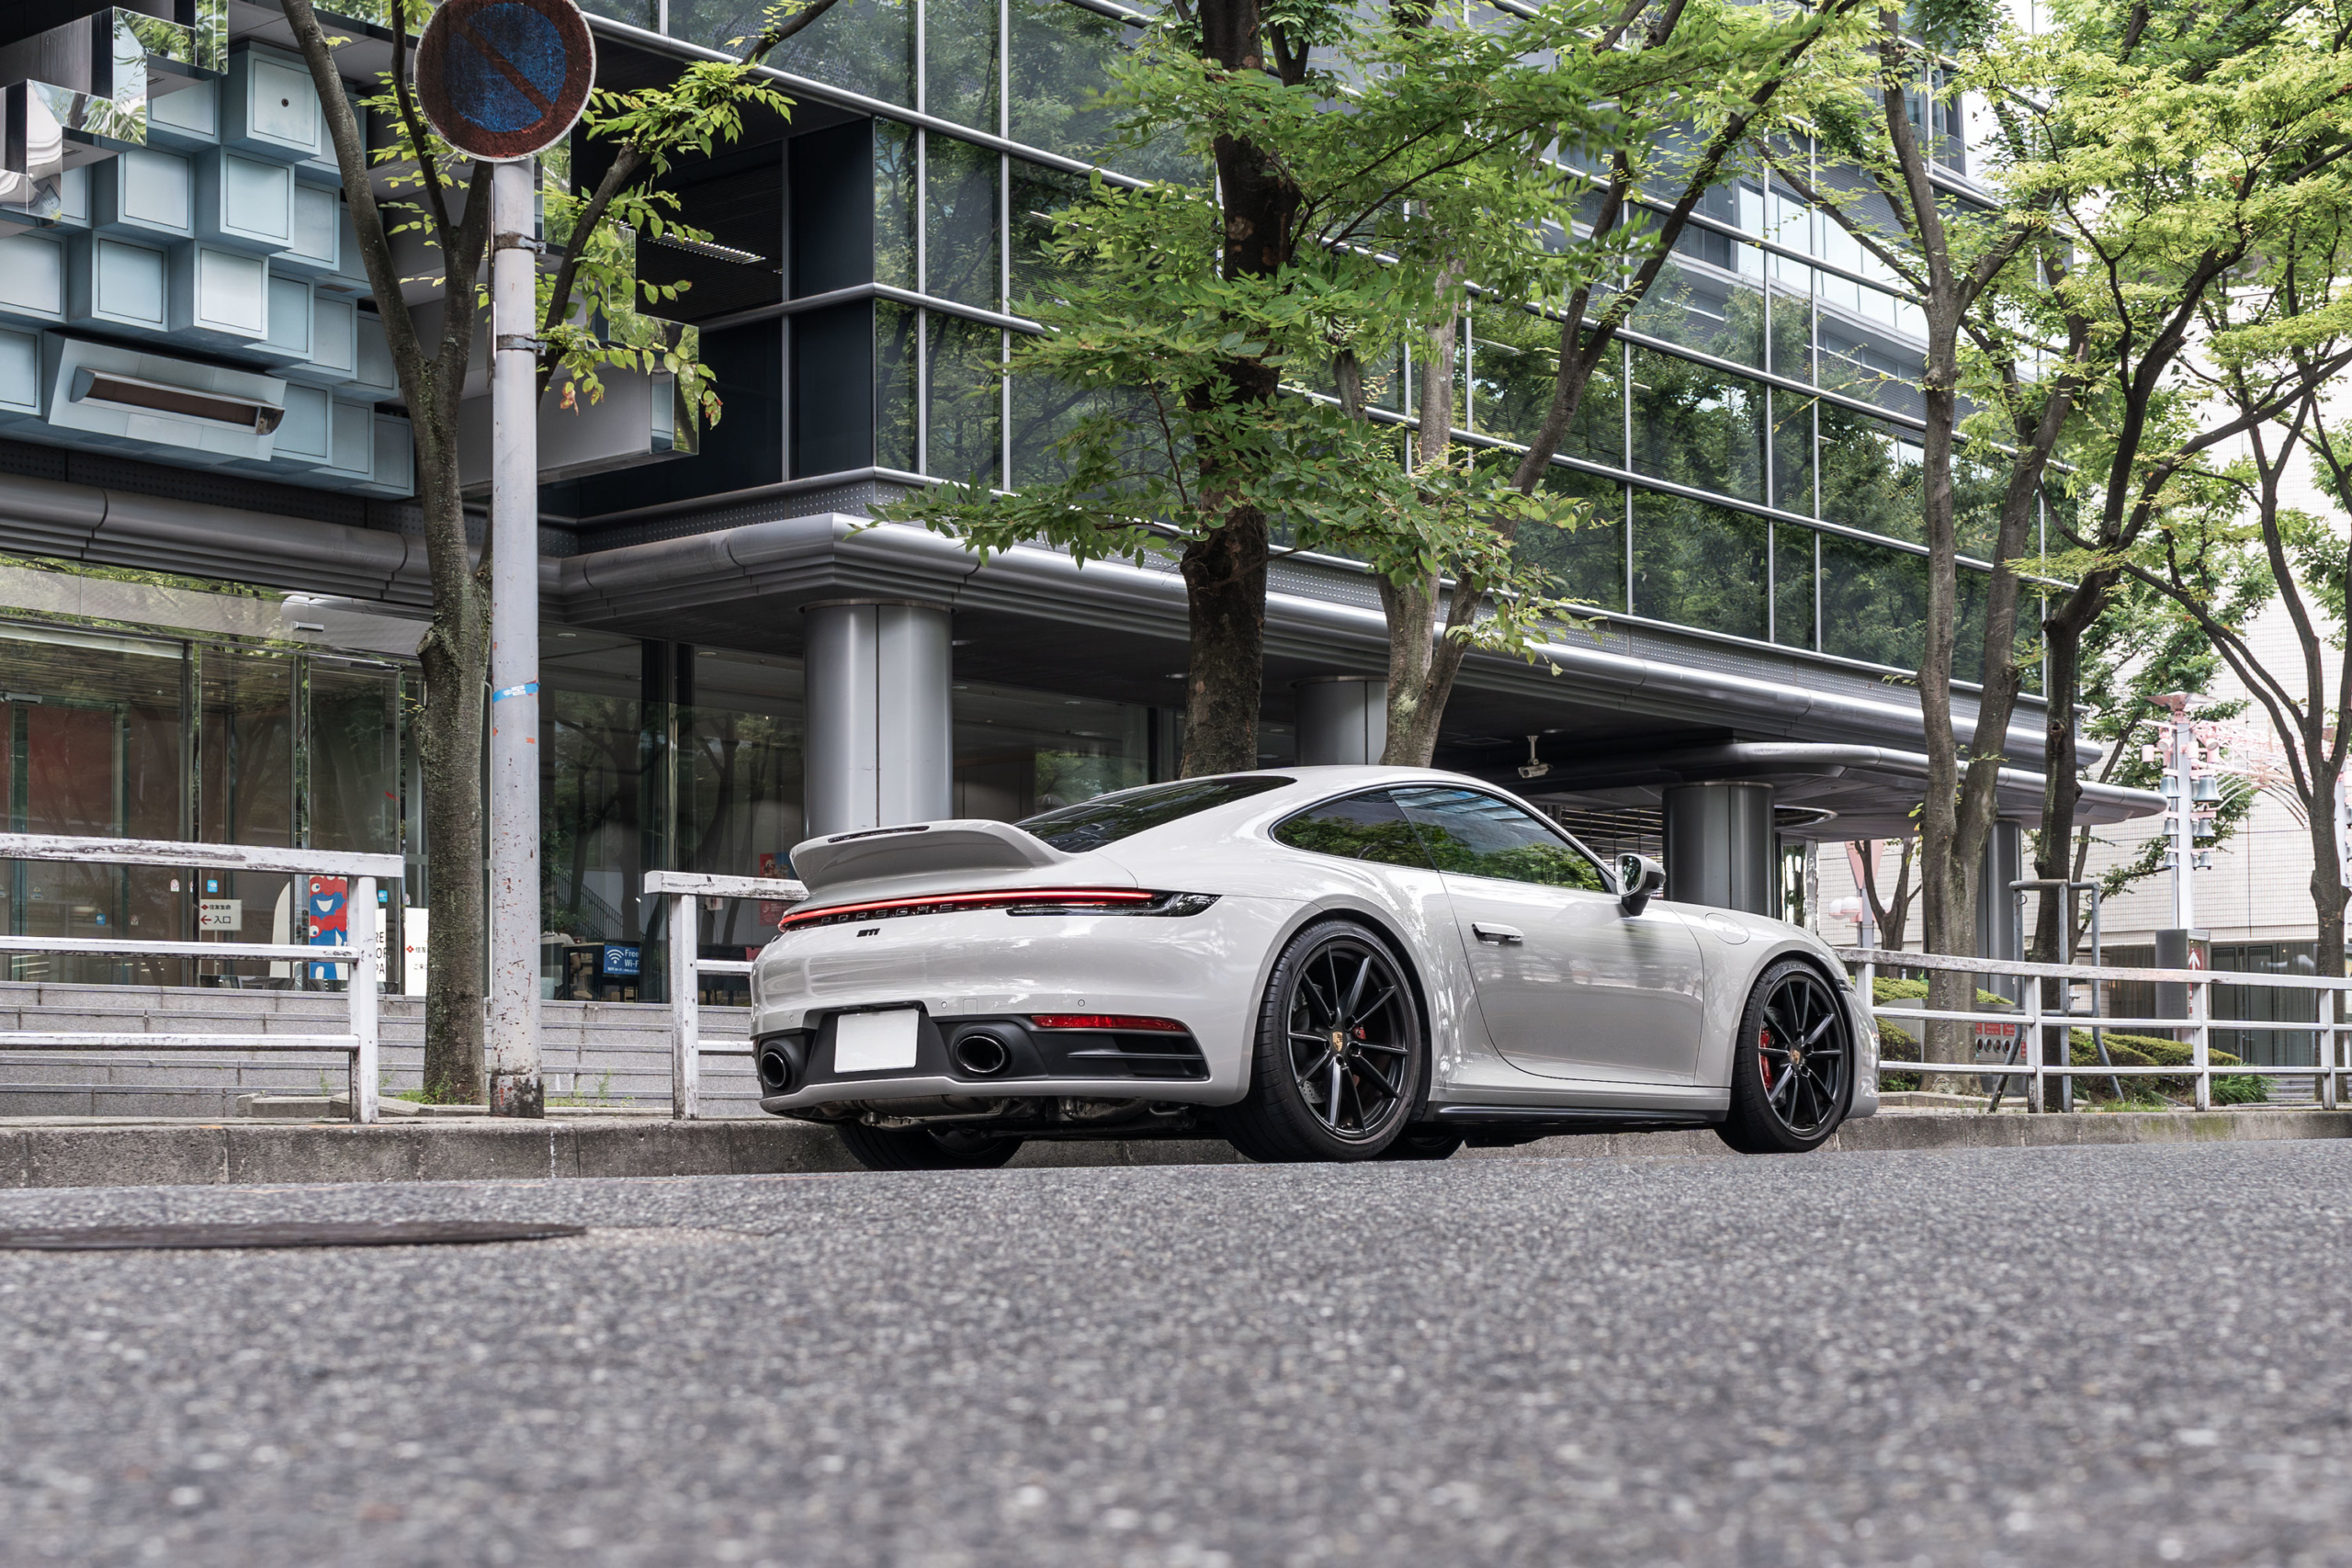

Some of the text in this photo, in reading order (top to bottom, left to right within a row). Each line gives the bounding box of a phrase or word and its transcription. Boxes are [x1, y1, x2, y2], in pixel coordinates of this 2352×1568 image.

[820, 903, 954, 926] PORSCHE
[213, 915, 232, 924] 入口
[856, 928, 880, 937] 911
[625, 949, 639, 958] Free
[624, 959, 639, 967] Wi-F
